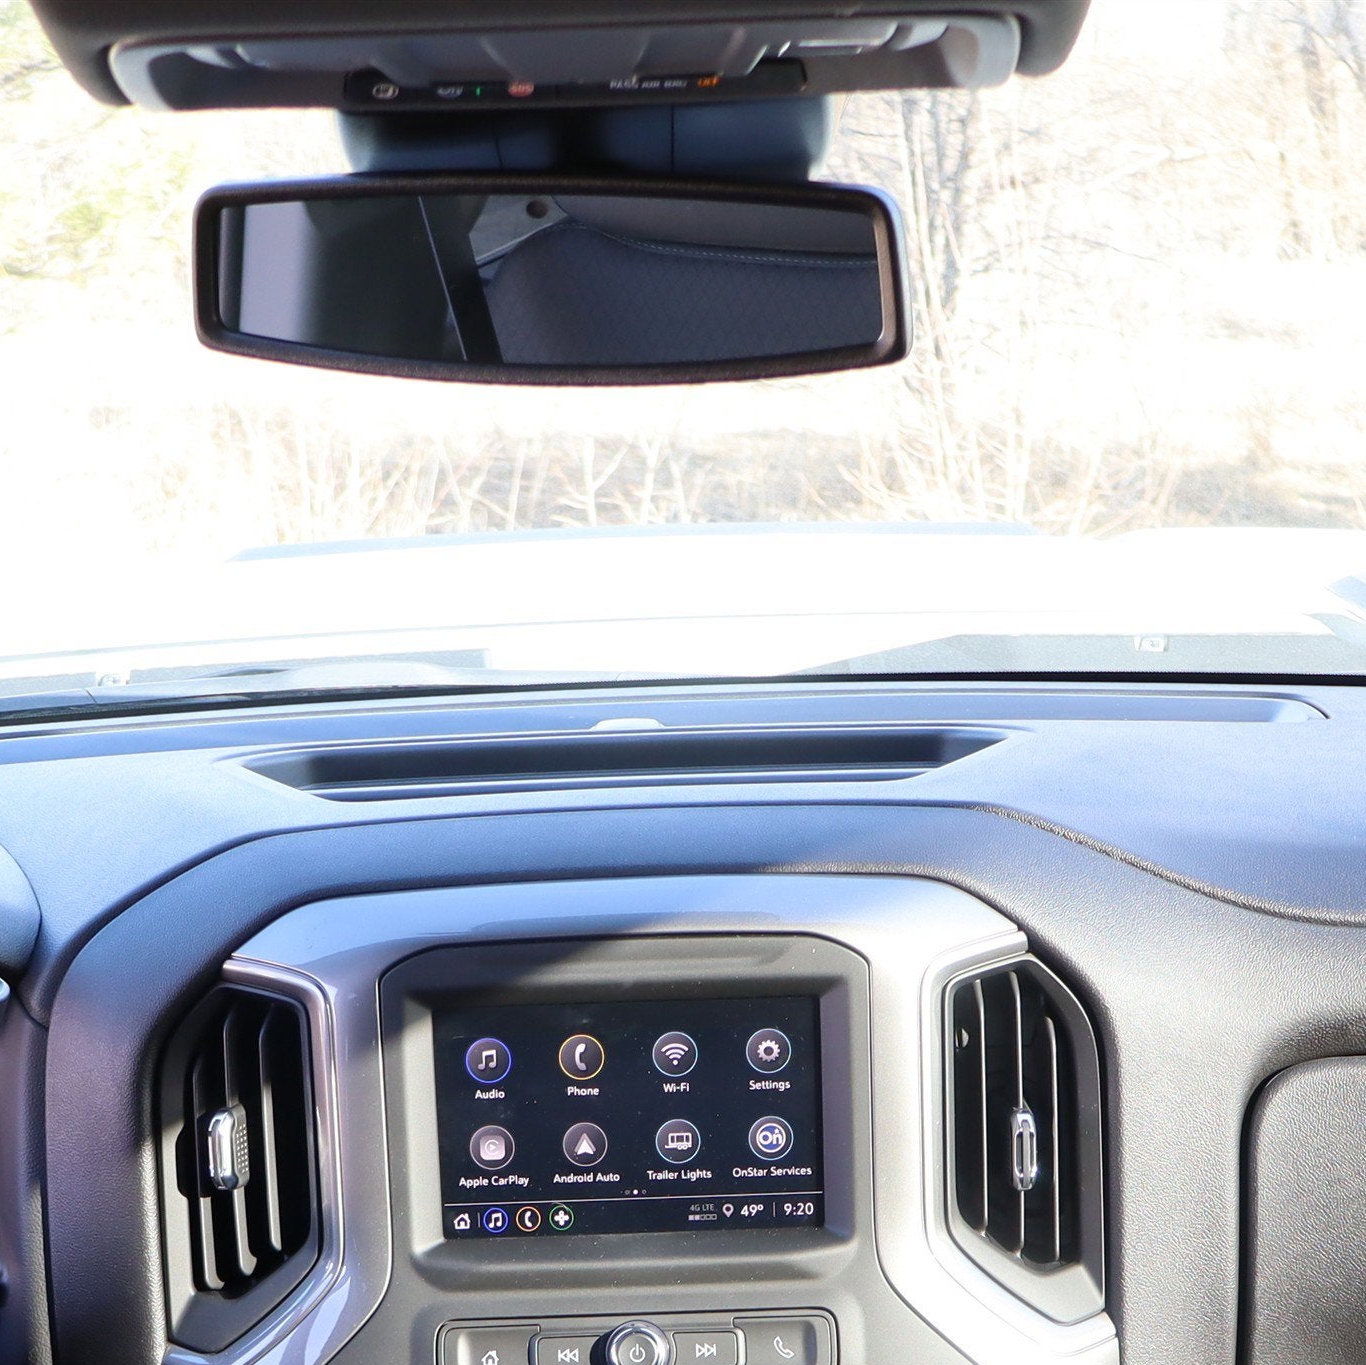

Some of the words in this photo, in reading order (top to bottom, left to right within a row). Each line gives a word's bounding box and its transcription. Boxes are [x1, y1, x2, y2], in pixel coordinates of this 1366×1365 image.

[567, 1086, 600, 1097] Phone
[663, 1082, 690, 1093] Wi-Fi
[748, 1080, 791, 1092] Settings
[474, 1089, 506, 1100] Audio
[553, 1173, 594, 1184] Android
[595, 1172, 621, 1183] Auto
[646, 1169, 679, 1181] Trailer
[681, 1169, 712, 1182] Lights
[732, 1167, 768, 1178] OnStar
[770, 1166, 813, 1177] Services
[458, 1177, 489, 1188] Apple
[491, 1174, 530, 1187] CarPlay
[689, 1203, 701, 1212] 4G
[702, 1203, 715, 1212] LTE
[783, 1202, 815, 1216] 9:20
